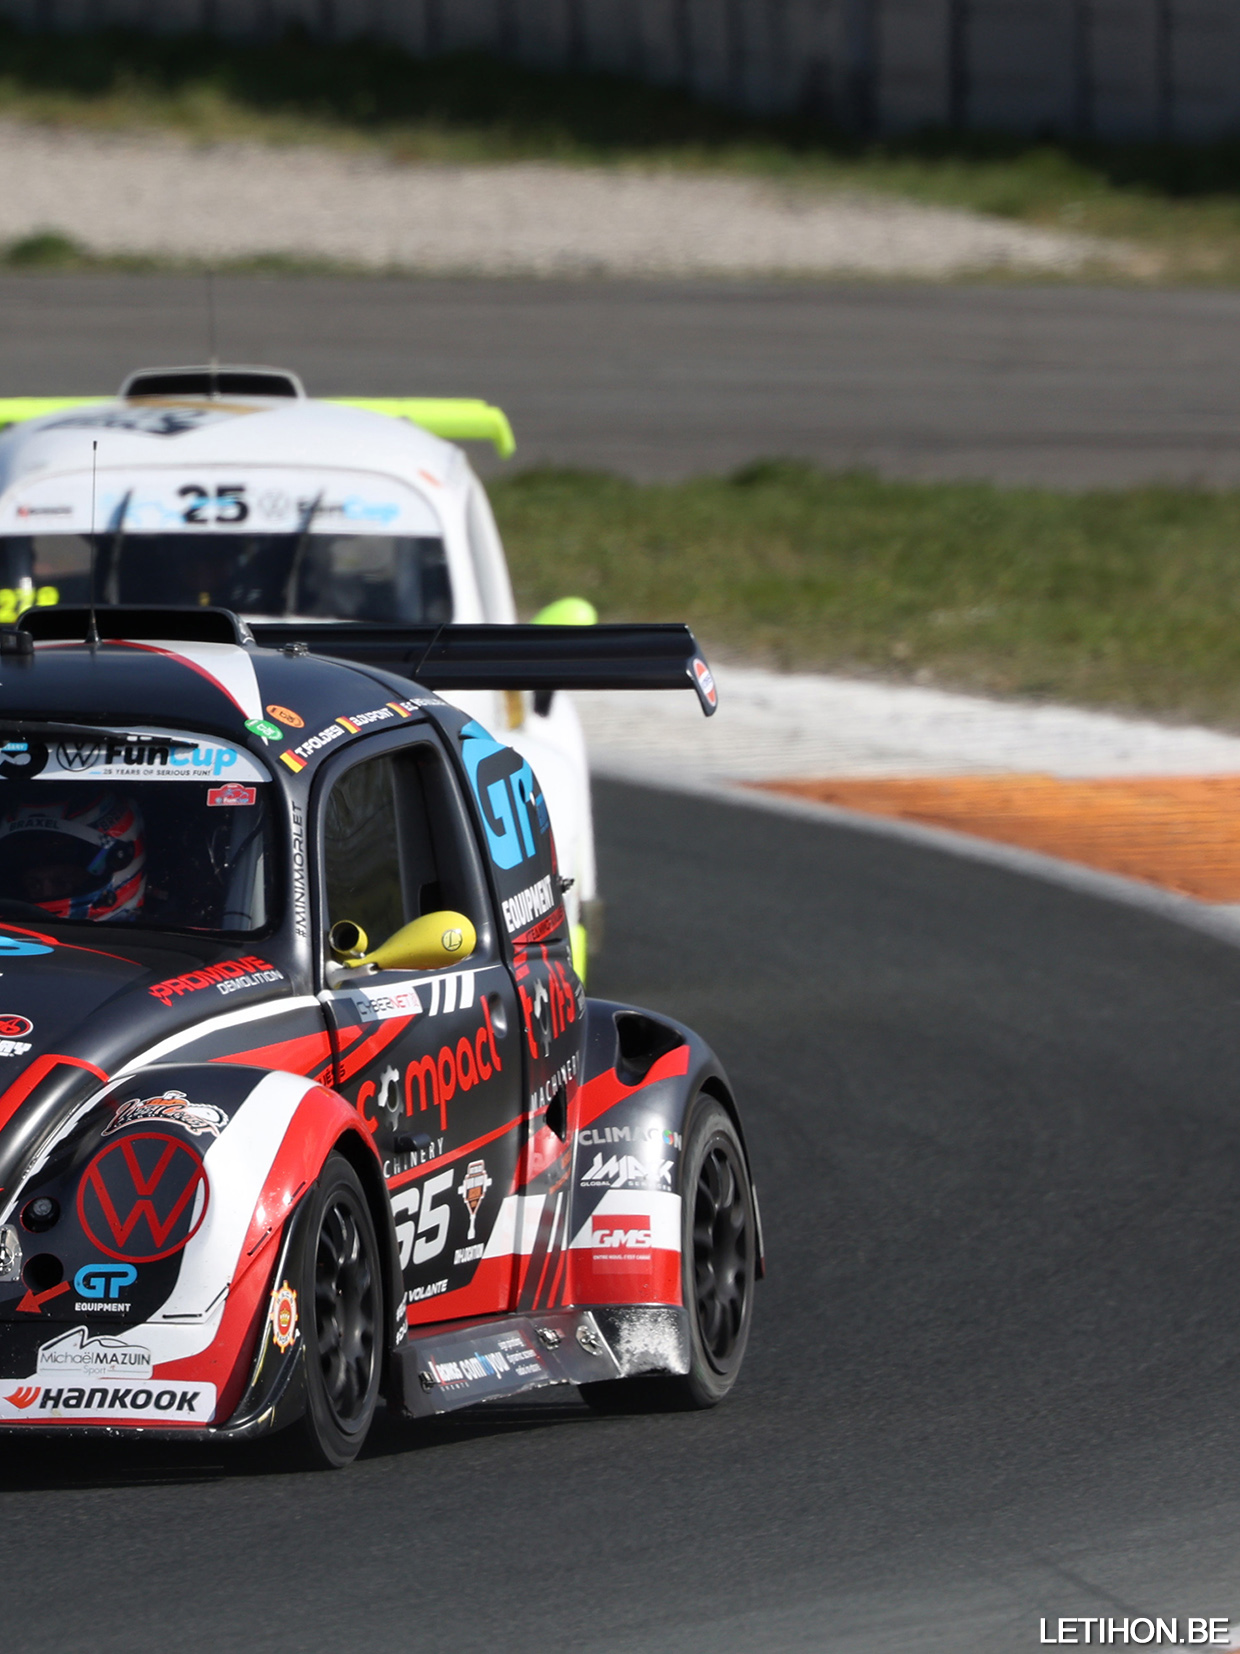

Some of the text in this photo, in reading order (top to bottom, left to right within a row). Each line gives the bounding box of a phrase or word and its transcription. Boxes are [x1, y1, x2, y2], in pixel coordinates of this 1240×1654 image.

[178, 485, 249, 524] 25
[105, 740, 237, 776] FunCup
[156, 768, 190, 776] SERIOUS
[292, 801, 307, 938] #MINIMORLET
[501, 874, 555, 934] EQUIPMENT
[148, 955, 275, 1007] PROMOVE
[216, 969, 284, 995] DEMOLITION
[383, 1137, 444, 1179] CHINERY
[592, 1229, 653, 1248] GMS
[73, 1263, 138, 1299] GP
[408, 1279, 449, 1302] VOLANTE
[74, 1302, 131, 1312] EQUIPMENT
[83, 1365, 106, 1375] Sport
